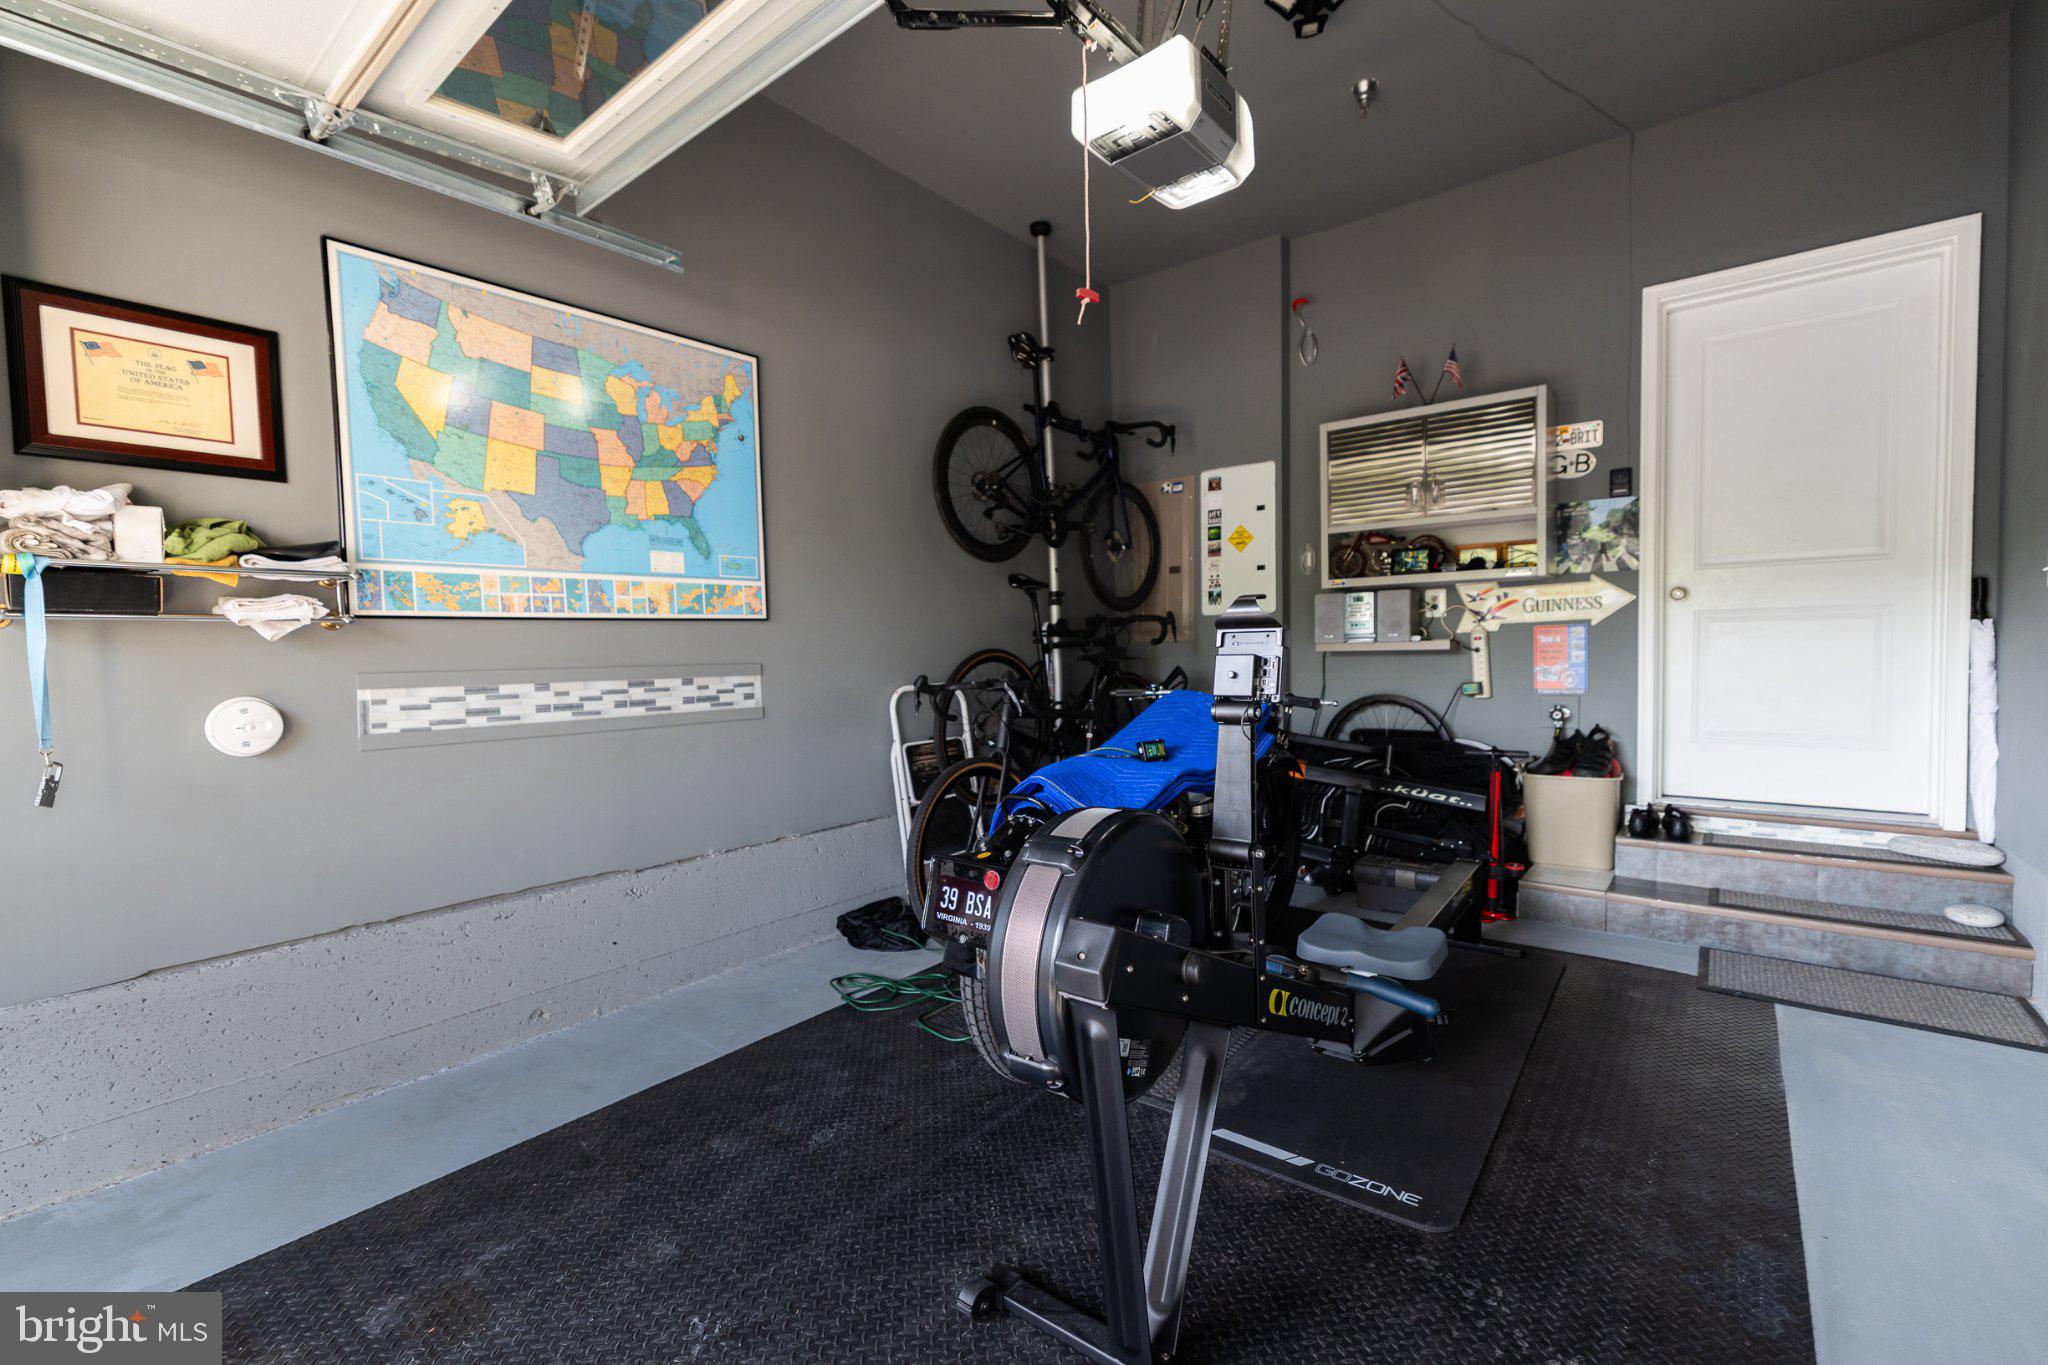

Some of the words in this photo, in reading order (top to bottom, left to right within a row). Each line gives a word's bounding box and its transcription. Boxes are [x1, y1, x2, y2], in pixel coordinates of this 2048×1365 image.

[135, 359, 152, 367] THE
[122, 368, 156, 379] UNITED
[158, 376, 191, 385] STATES
[144, 379, 184, 391] AMERICA
[1522, 595, 1604, 614] GUINNESS
[940, 885, 959, 910] 39
[964, 891, 993, 919] BSA
[936, 911, 968, 926] VIRGINIA
[1314, 1162, 1424, 1208] GOZONE
